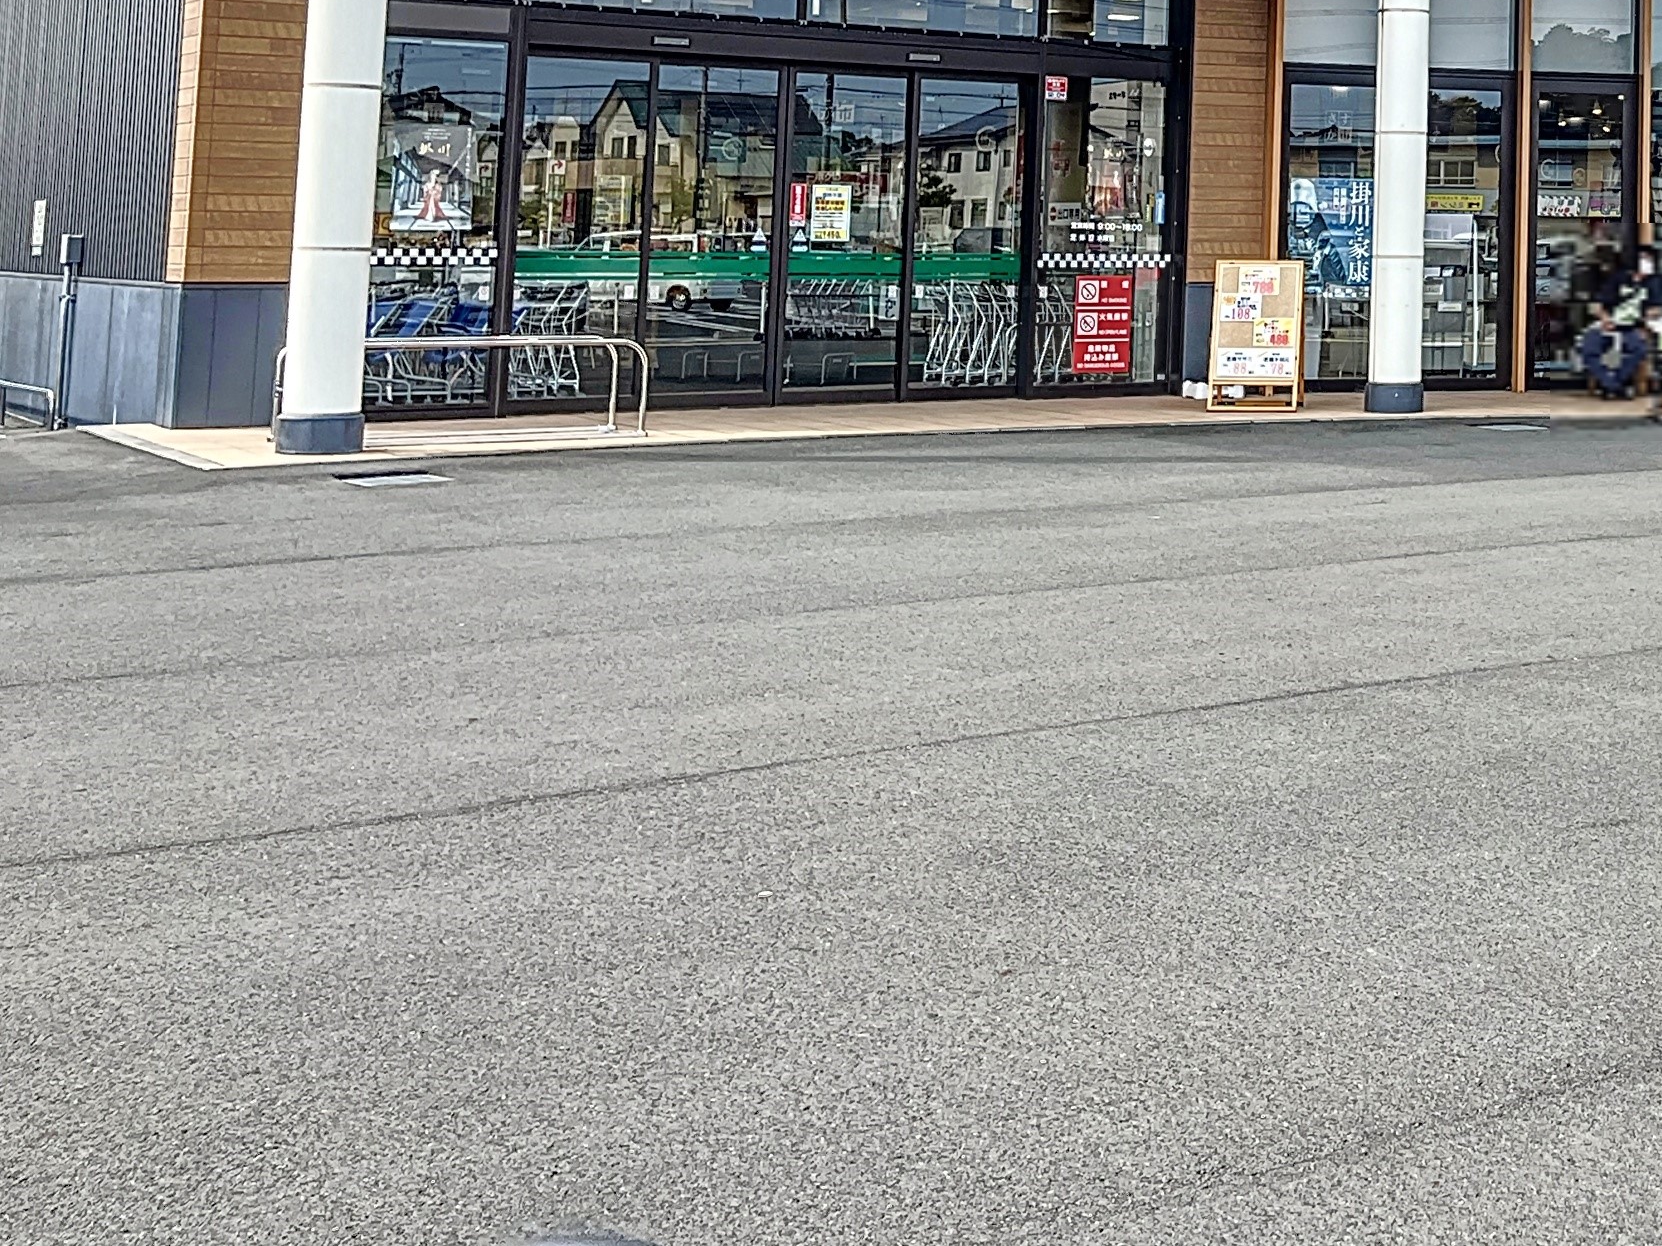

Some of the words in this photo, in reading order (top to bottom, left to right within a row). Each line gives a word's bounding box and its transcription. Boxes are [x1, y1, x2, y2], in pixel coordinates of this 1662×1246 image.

[1348, 180, 1372, 284] 掛川と家康
[1231, 308, 1251, 320] 108
